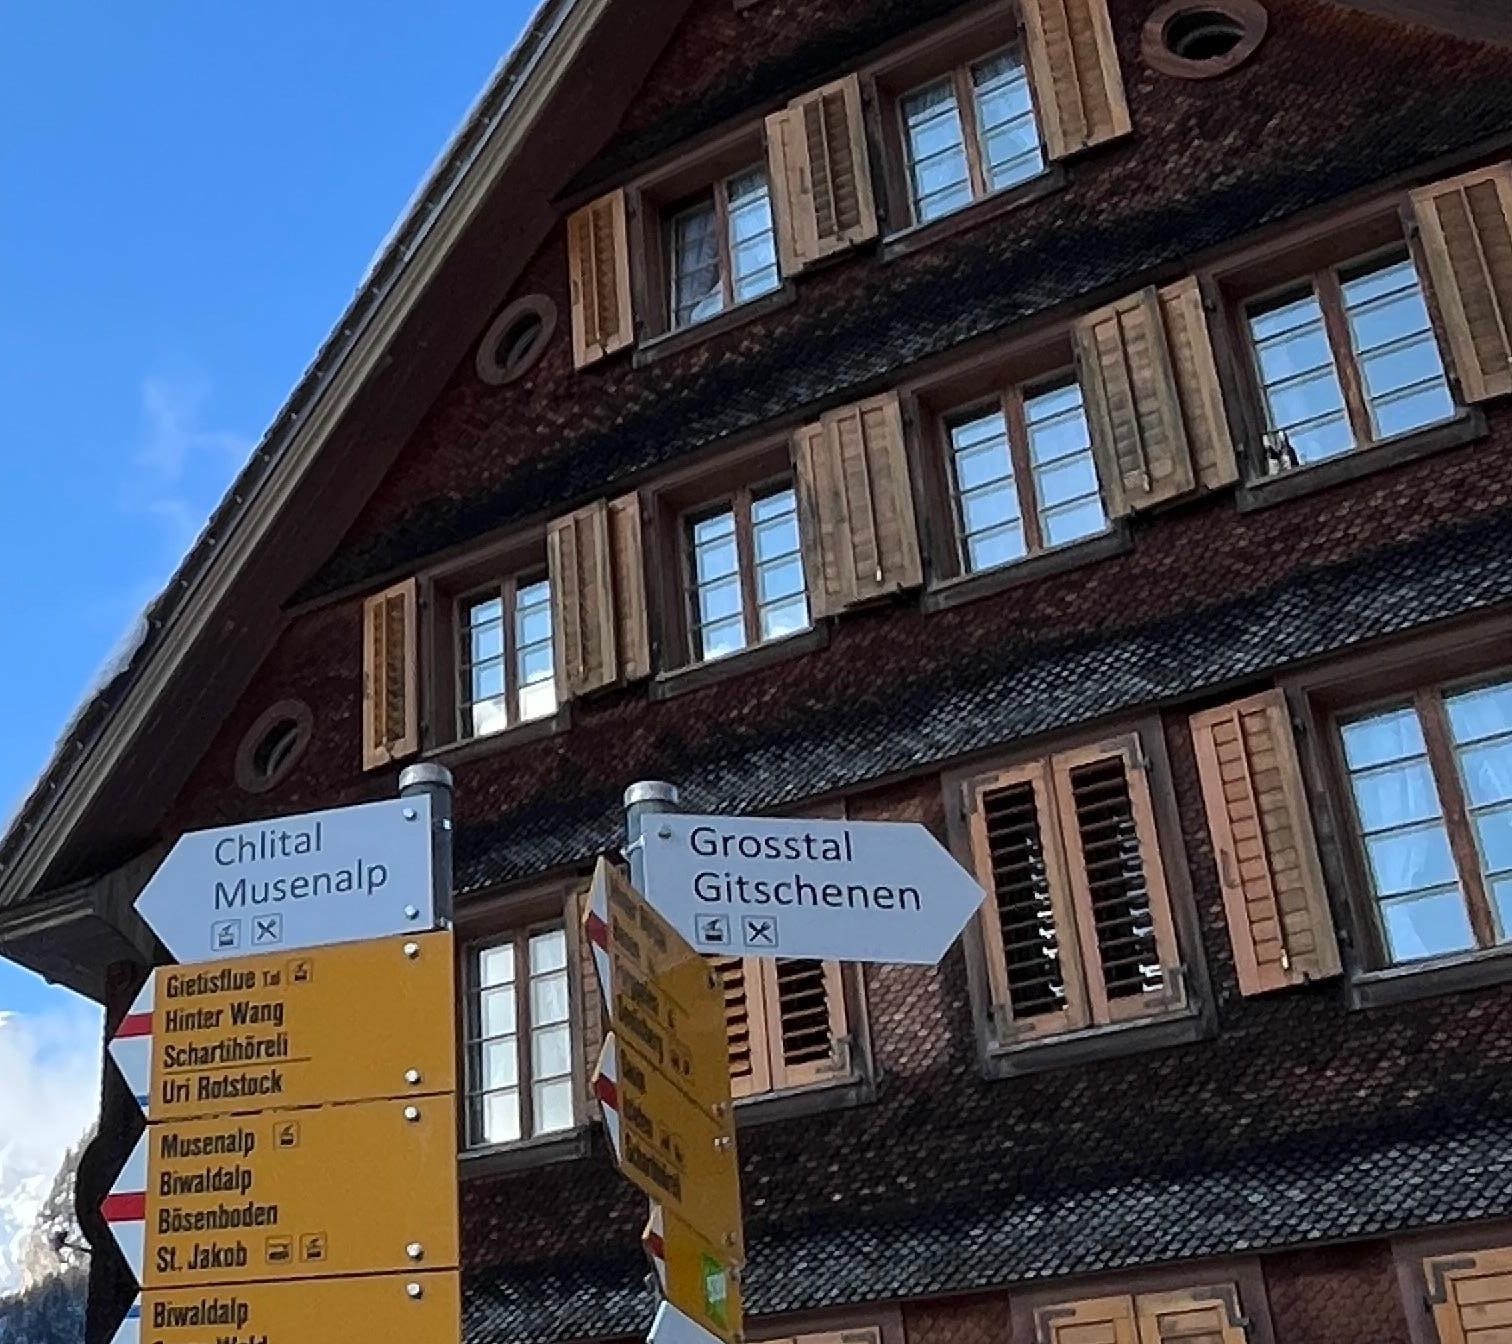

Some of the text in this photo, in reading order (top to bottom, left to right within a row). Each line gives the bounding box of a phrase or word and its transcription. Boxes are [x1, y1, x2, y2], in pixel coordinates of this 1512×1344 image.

[215, 821, 321, 866] Chlital
[690, 826, 852, 862] Grosstal
[215, 859, 387, 910] Musenalp
[694, 872, 921, 911] Gitschenen
[165, 1001, 283, 1033] Hinter Wang
[163, 1069, 282, 1104] Uri Rotstock
[161, 1128, 255, 1158] Musenalp
[160, 1165, 252, 1196] Biwaldalp
[158, 1201, 278, 1234] Bösenboden
[157, 1241, 247, 1273] St. Jakob
[153, 1297, 248, 1329] Biwaldalp
